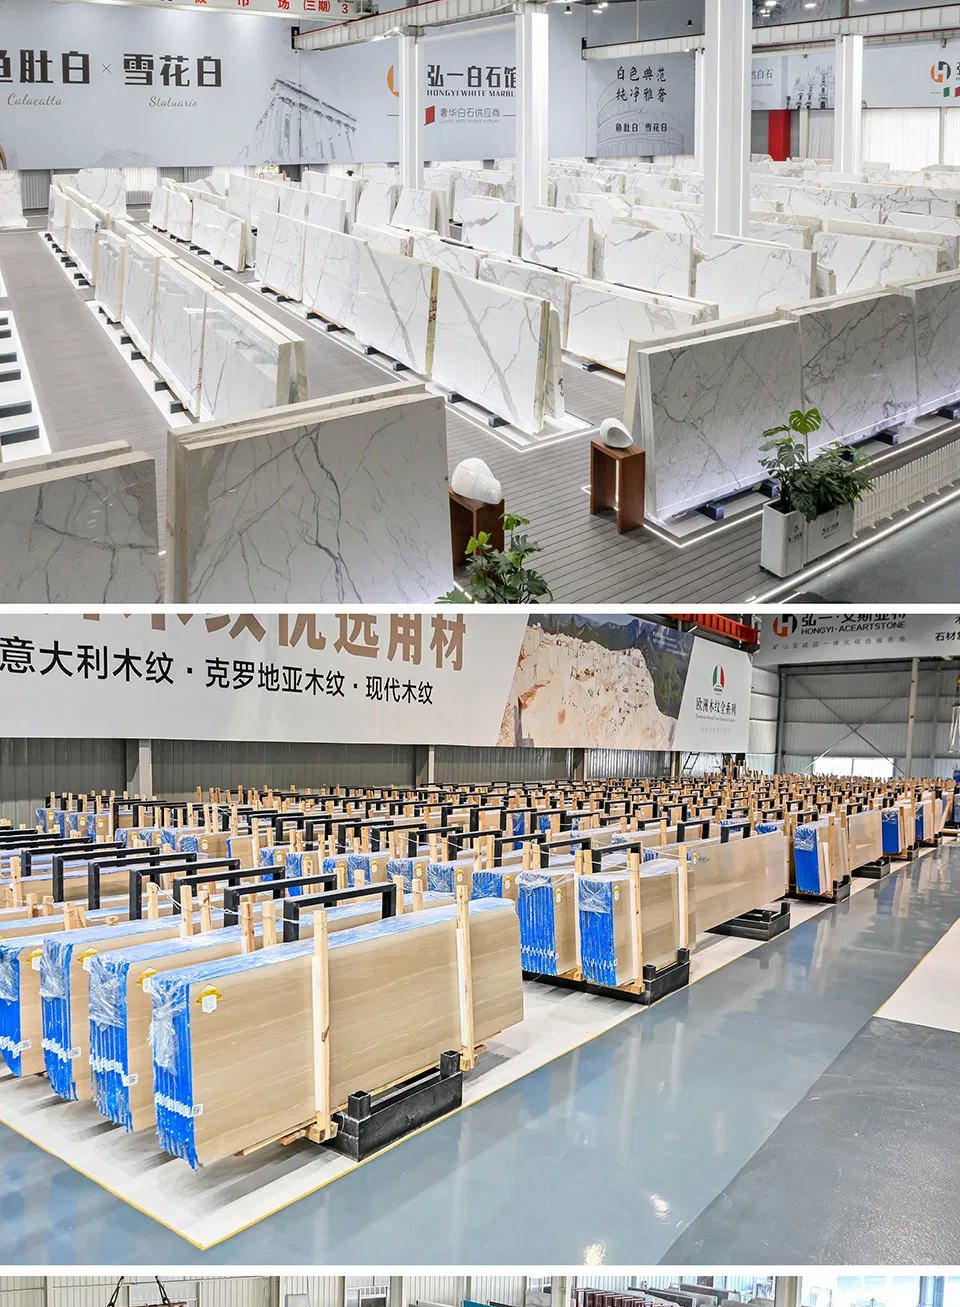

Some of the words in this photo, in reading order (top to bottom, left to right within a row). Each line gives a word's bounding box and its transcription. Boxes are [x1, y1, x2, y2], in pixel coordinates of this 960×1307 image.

[341, 4, 348, 13] 3
[123, 54, 222, 87] 雪花白
[616, 66, 667, 82] 白色典范
[426, 89, 459, 97] HONGYI
[461, 89, 487, 97] WHITE
[616, 86, 667, 102] 纯净雅奢
[7, 93, 63, 106] Calacatta
[148, 96, 198, 108] Statuario
[440, 107, 500, 118] 奢华白石供应商
[645, 123, 668, 133] 雪花白
[205, 657, 346, 698] 克罗地亚木纹
[365, 676, 434, 705] 现代木纹
